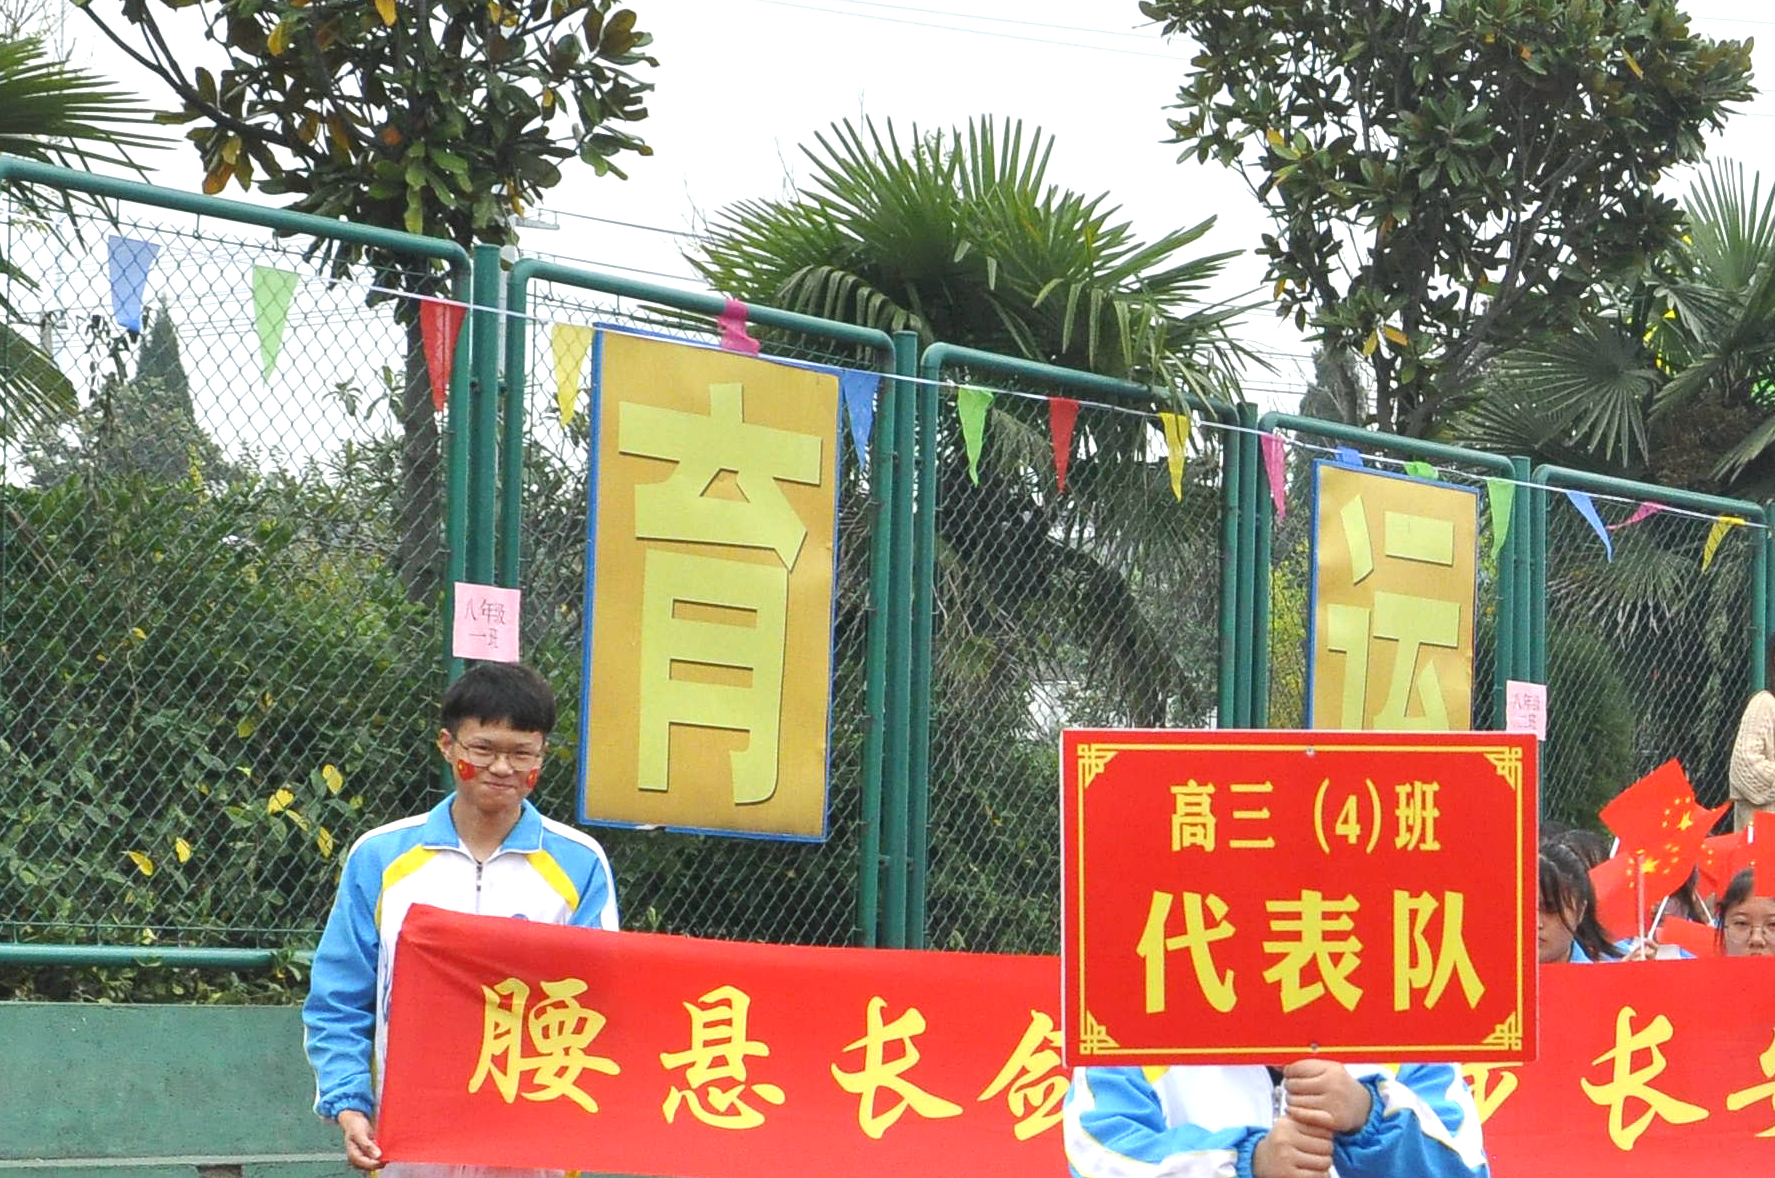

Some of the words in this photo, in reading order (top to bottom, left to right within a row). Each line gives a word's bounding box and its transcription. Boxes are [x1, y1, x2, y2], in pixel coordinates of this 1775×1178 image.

[617, 381, 823, 806] 育
[1326, 494, 1462, 730] 运
[1170, 778, 1442, 855] 高三(4)班
[1136, 889, 1487, 1014] 代表队
